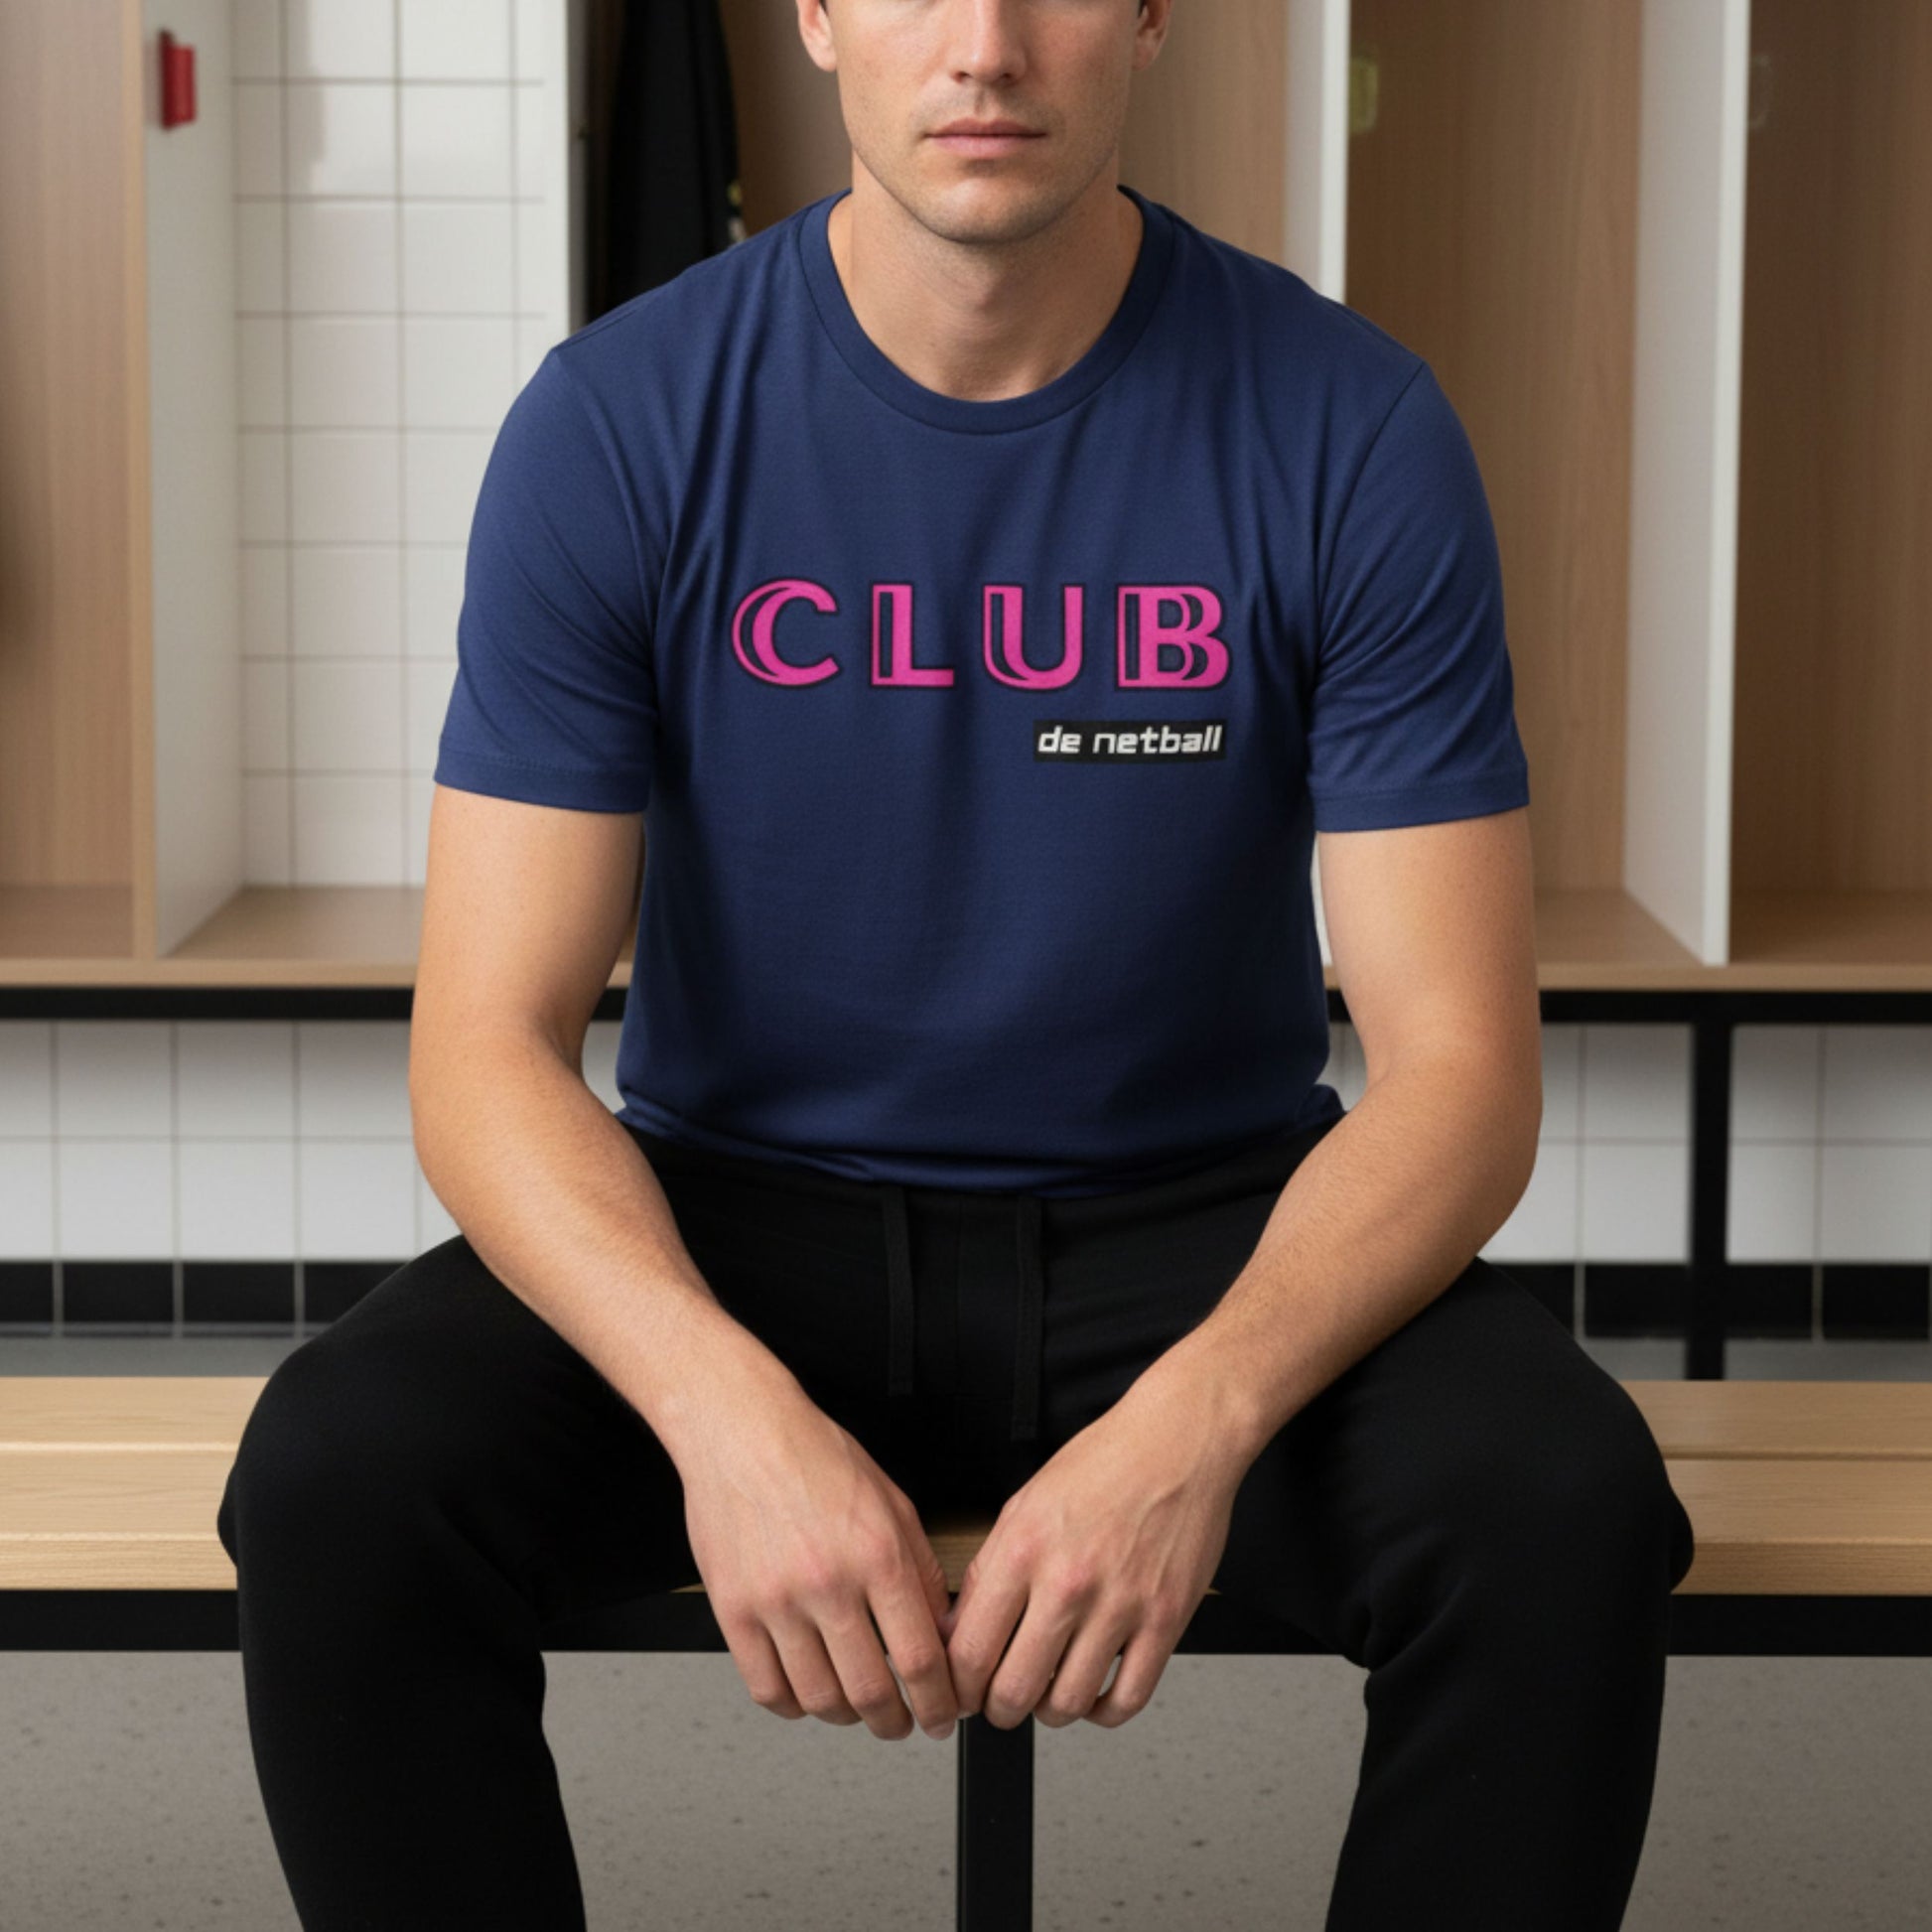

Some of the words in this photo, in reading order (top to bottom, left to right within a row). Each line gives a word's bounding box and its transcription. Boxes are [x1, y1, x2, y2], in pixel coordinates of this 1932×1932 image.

[731, 579, 1231, 691] CLUB
[1037, 726, 1081, 755] de
[1092, 726, 1223, 755] netball
